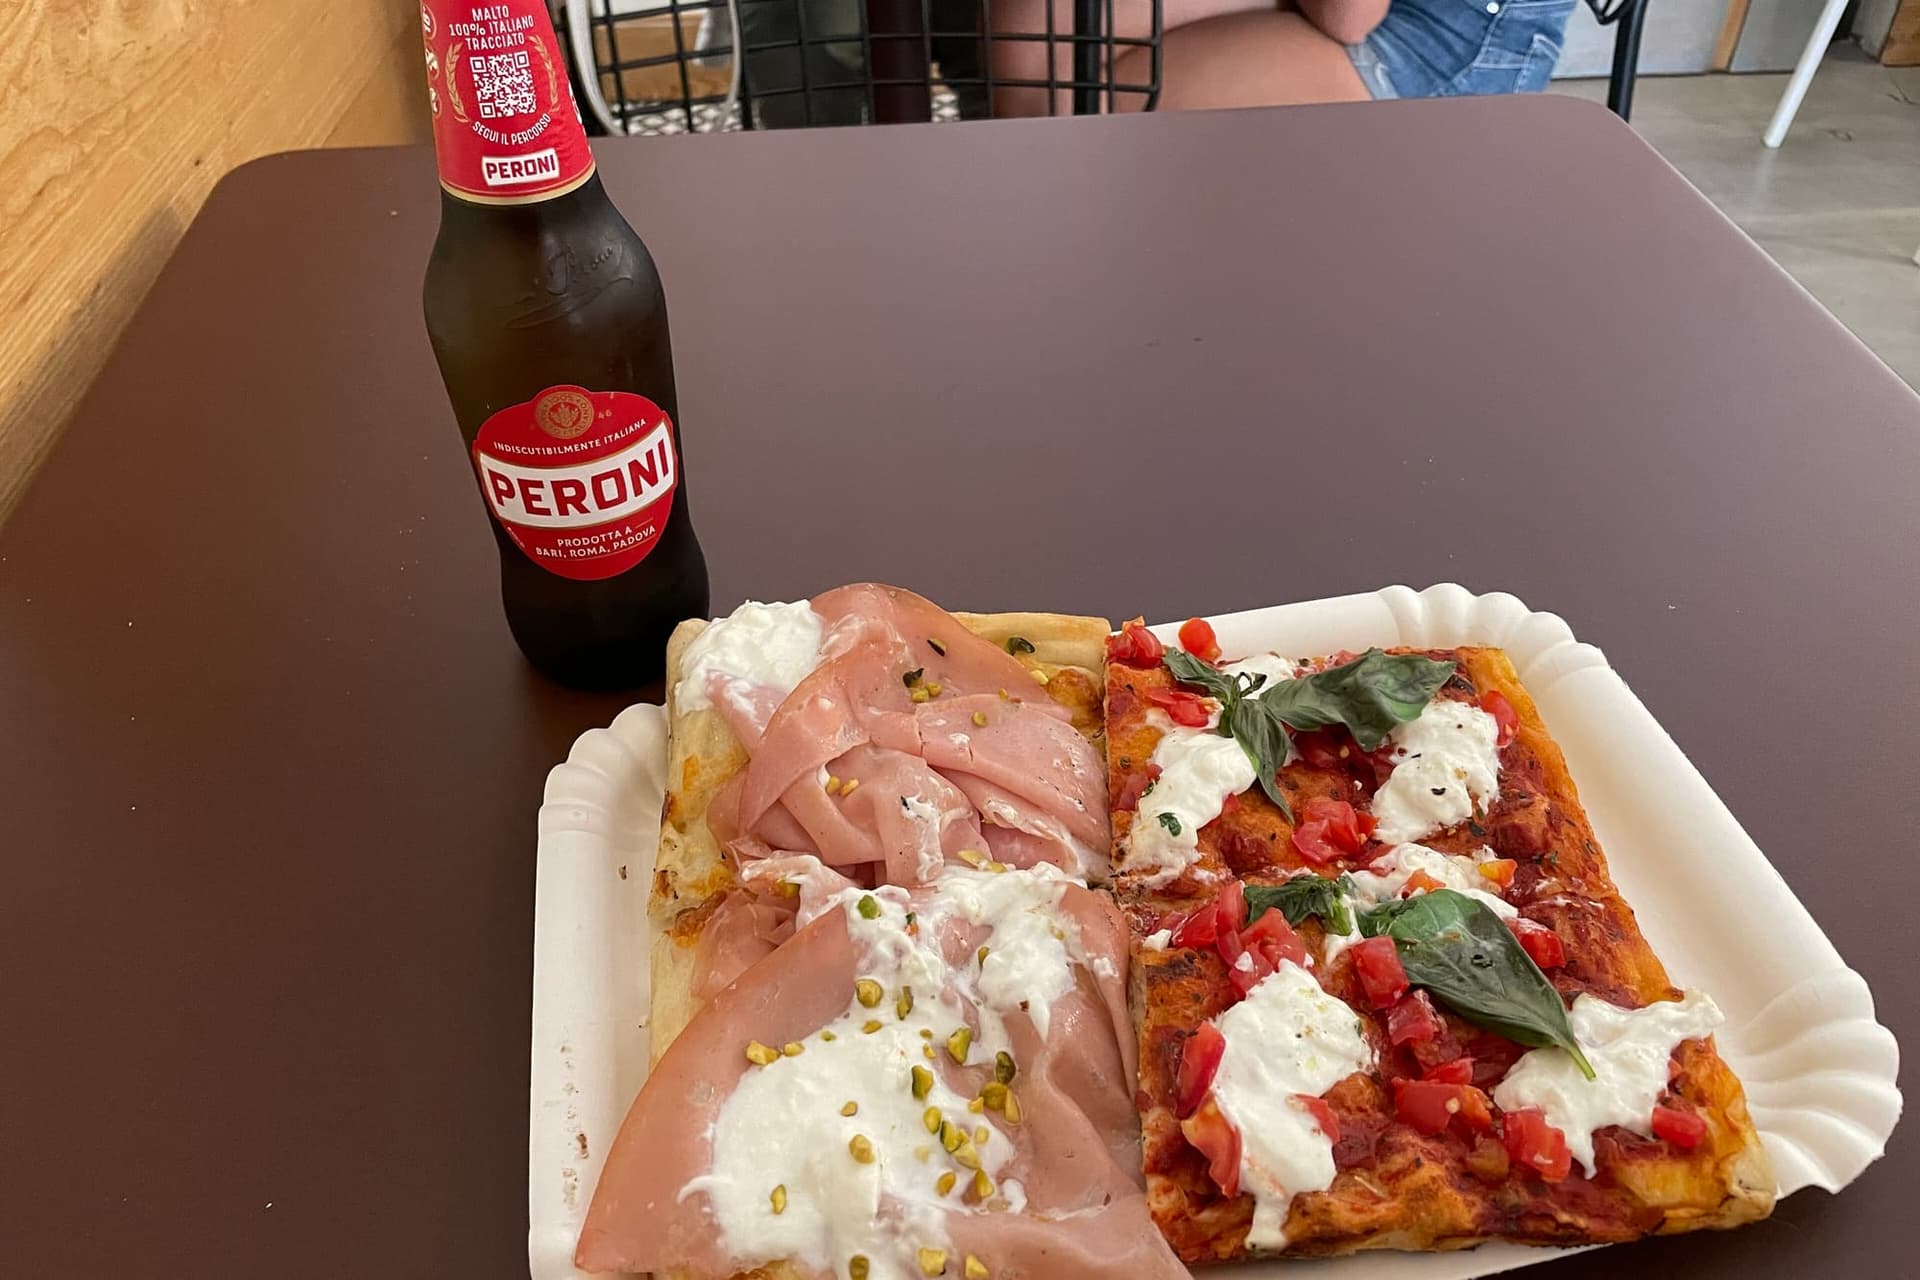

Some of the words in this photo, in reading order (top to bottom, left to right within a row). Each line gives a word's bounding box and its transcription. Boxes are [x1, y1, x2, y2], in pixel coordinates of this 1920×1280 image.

[449, 25, 486, 36] 100%
[488, 15, 534, 35] ITALIANO
[472, 5, 509, 22] MALTO
[465, 32, 525, 51] TRACCIATO
[472, 121, 499, 143] SEGUI
[501, 132, 509, 145] IL
[511, 113, 551, 145] PERCORSO
[485, 154, 556, 179] PERONI
[493, 439, 601, 455] INDISCUTIBILMENTE
[603, 418, 646, 444] ITALIANA
[487, 439, 669, 516] PERONI
[535, 547, 567, 558] BARI,
[569, 546, 610, 558] ROMA,
[613, 525, 656, 550] PADOVA
[557, 530, 621, 547] PRODOTTA
[624, 525, 633, 535] A
